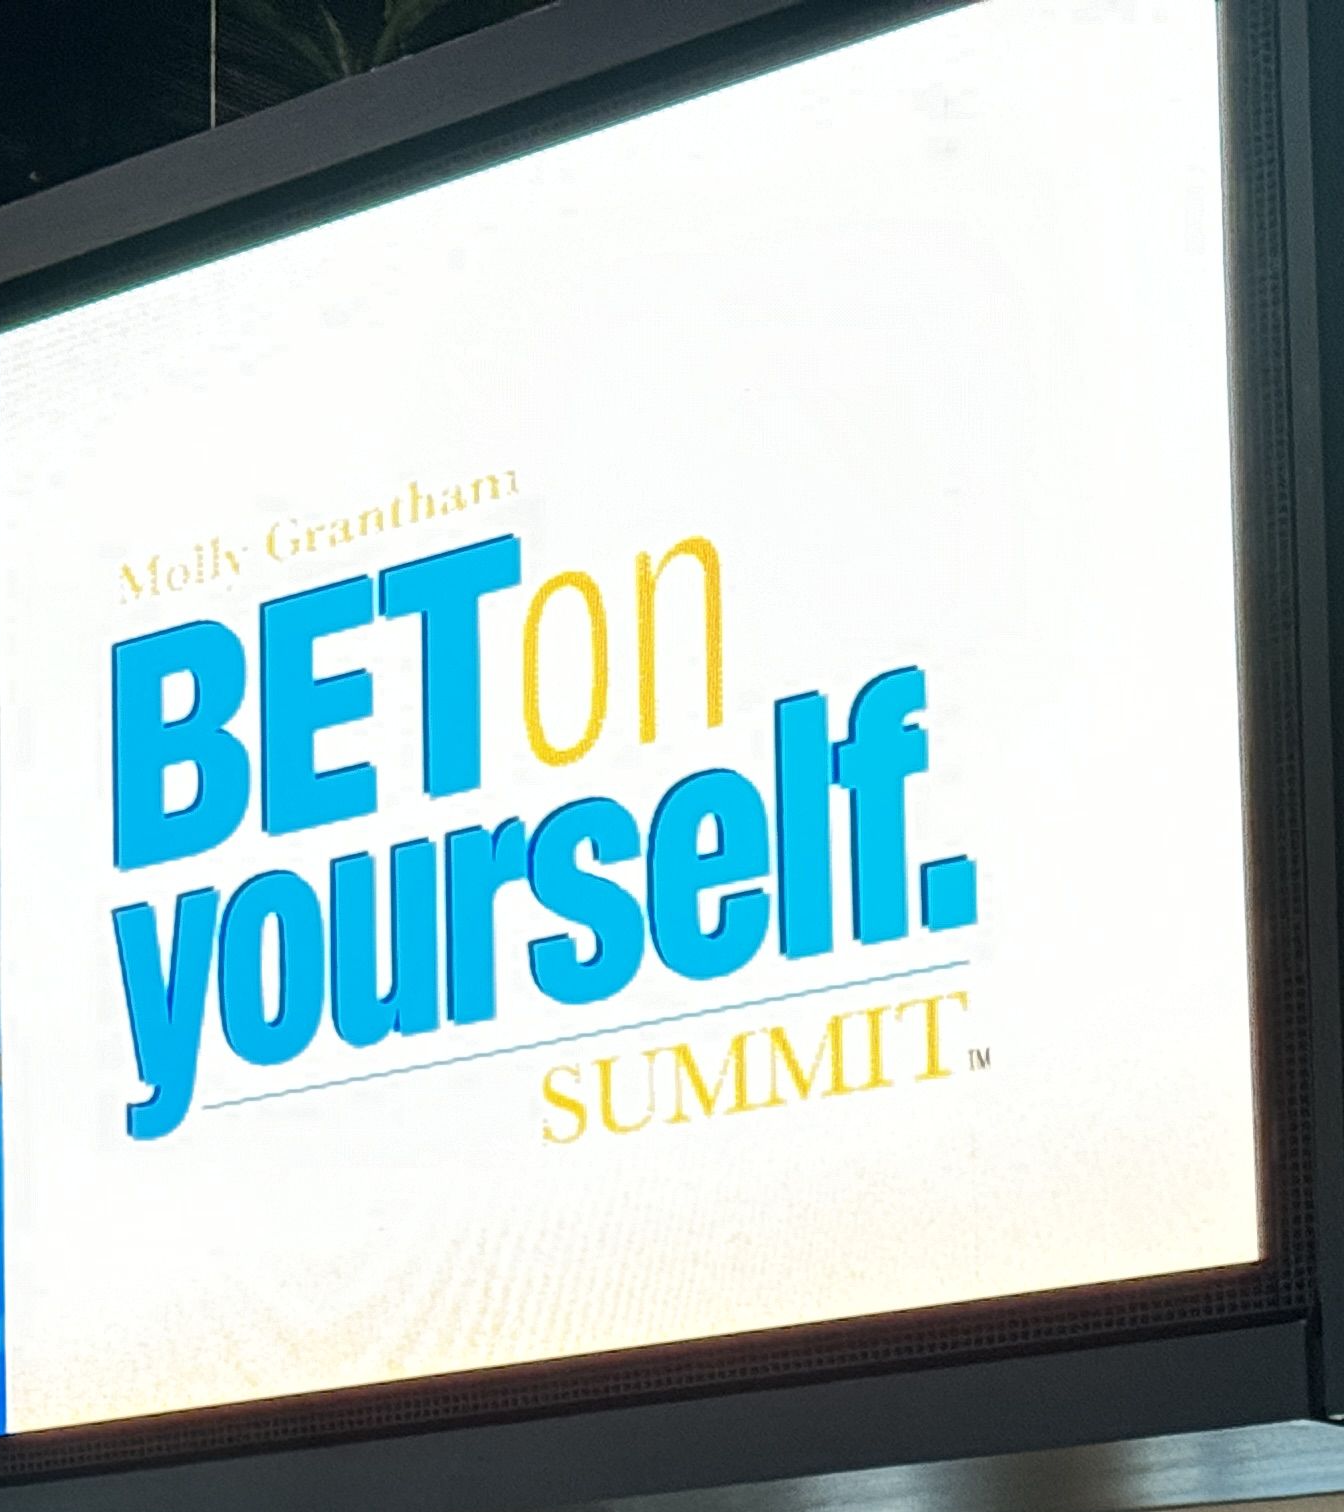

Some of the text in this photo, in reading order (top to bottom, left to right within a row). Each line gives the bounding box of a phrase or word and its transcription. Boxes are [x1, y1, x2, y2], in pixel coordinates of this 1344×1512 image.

[119, 469, 520, 605] Molly Grantham
[112, 665, 978, 1141] yourself.
[541, 990, 969, 1145] SUMMIT
